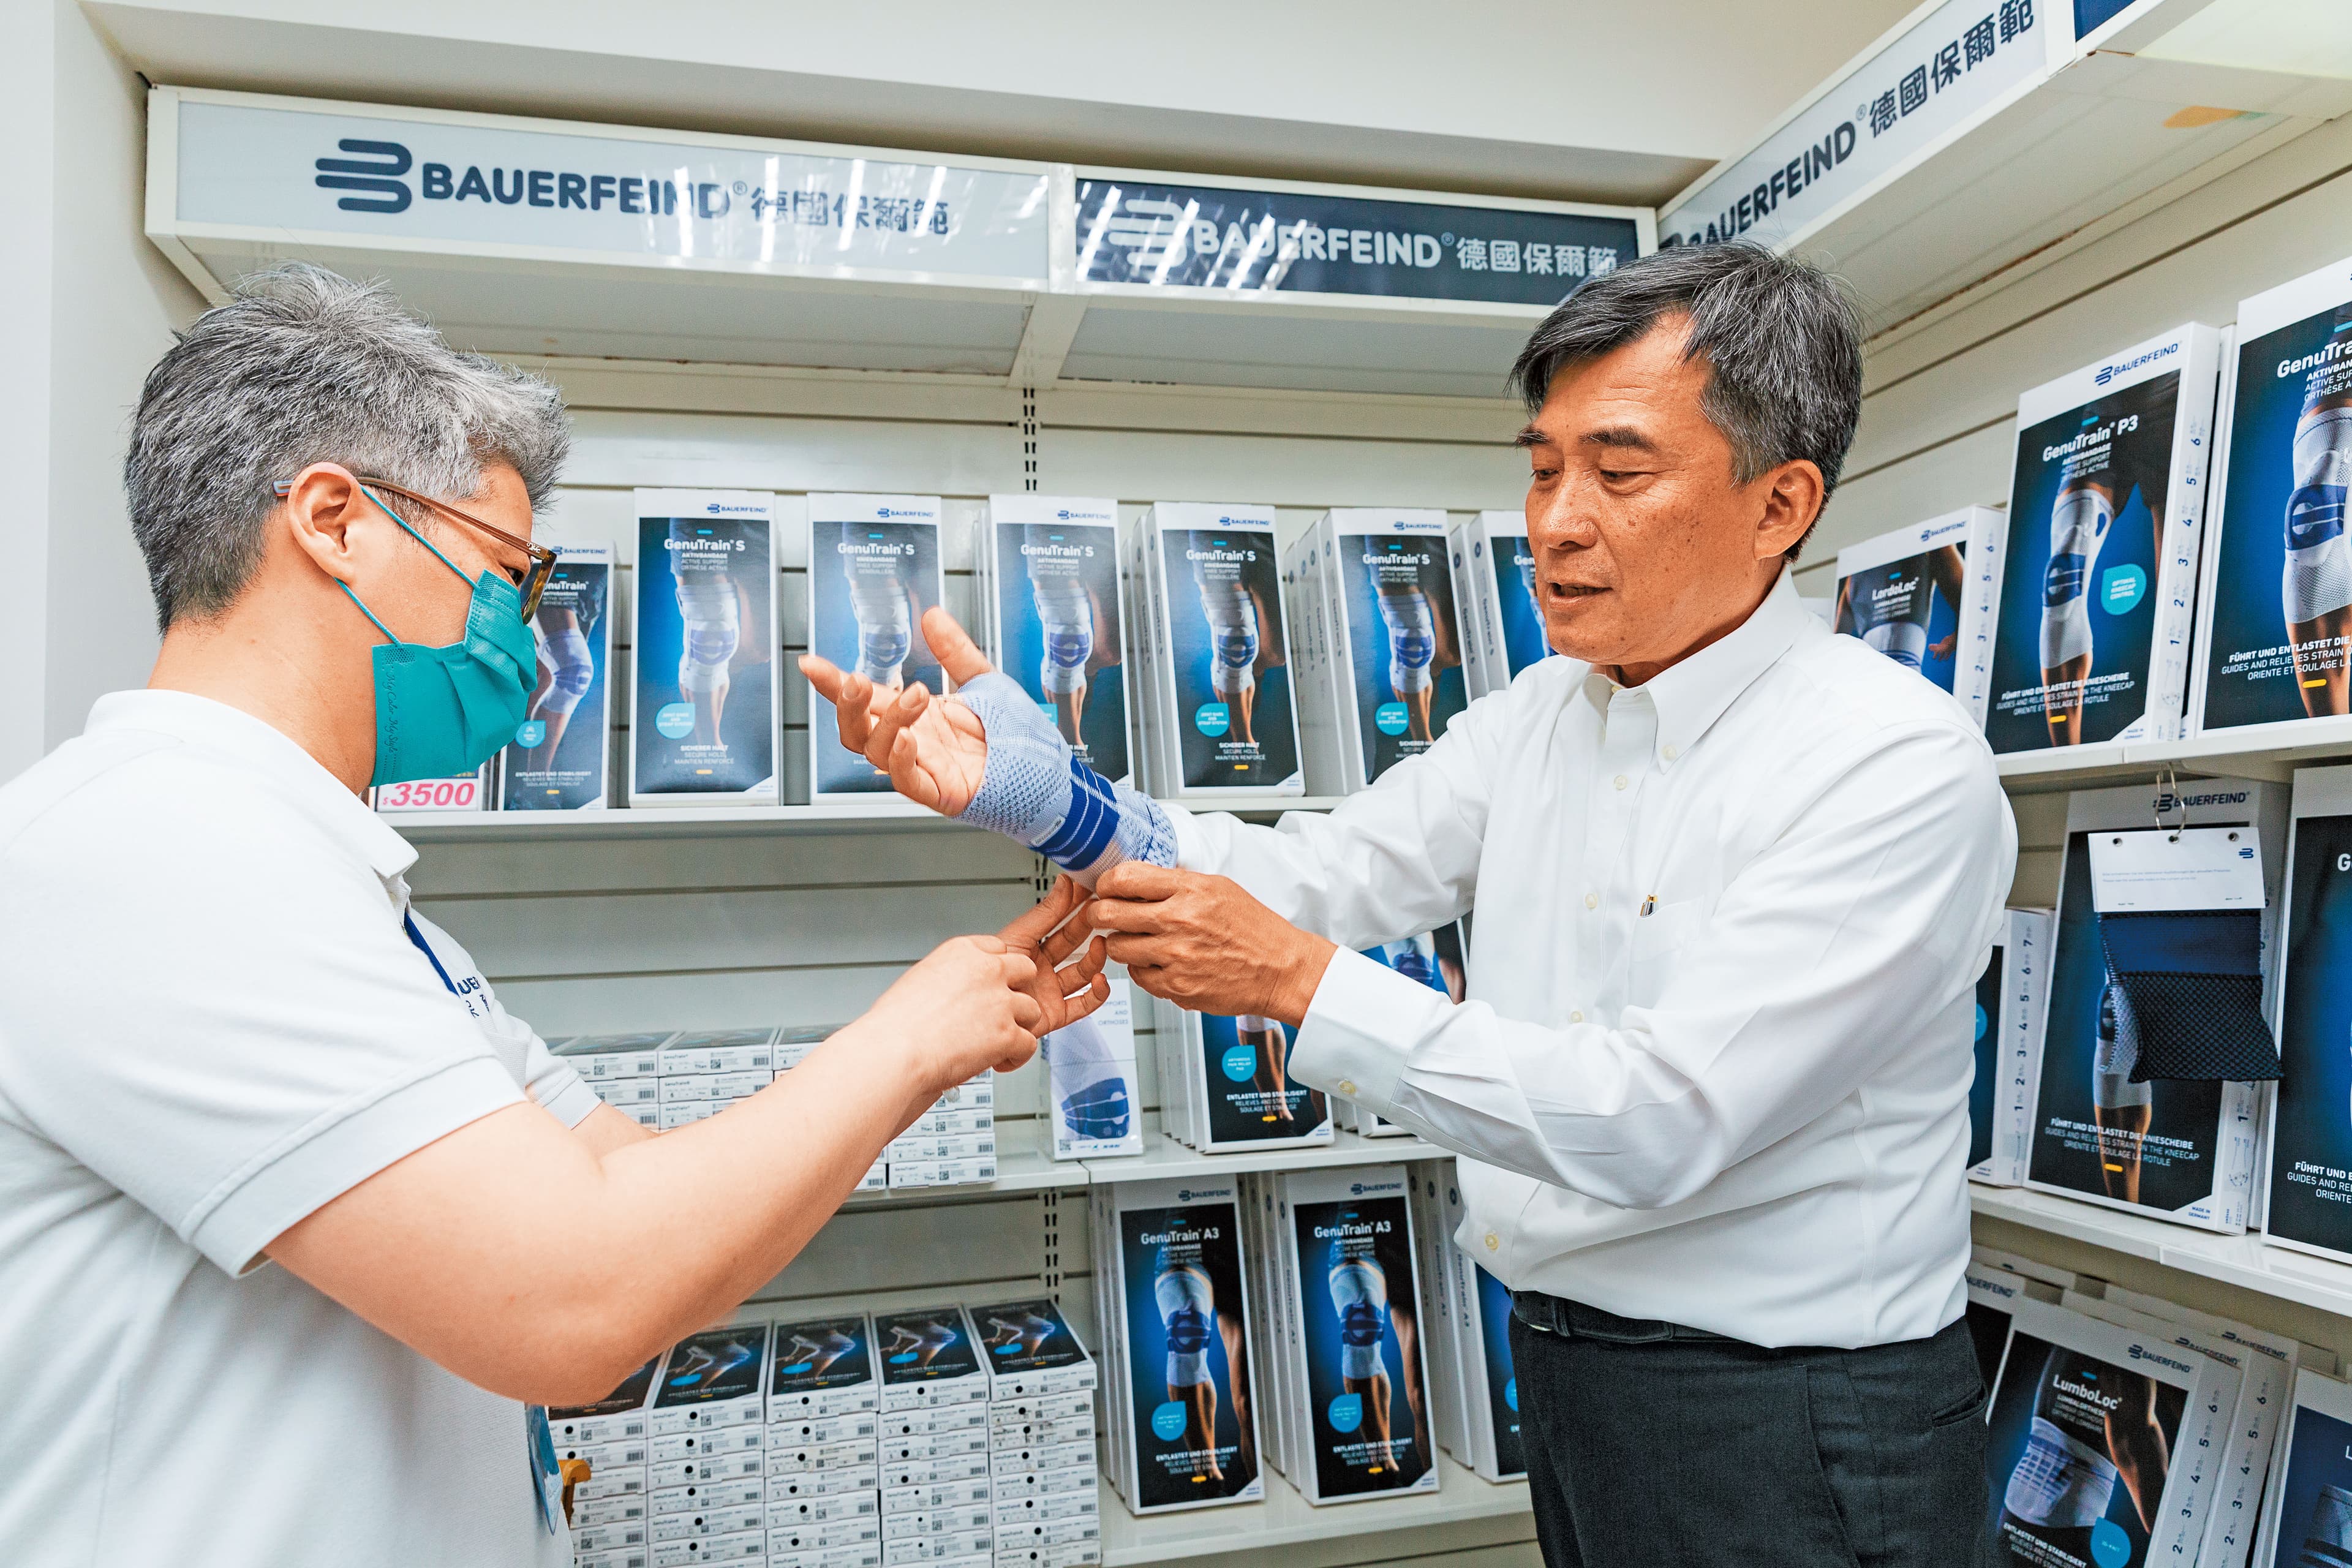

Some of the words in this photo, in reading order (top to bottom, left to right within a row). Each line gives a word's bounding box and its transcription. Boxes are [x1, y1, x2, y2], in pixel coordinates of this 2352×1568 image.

[751, 187, 949, 235] 德國保爾範
[2114, 343, 2178, 376] BAUERFEIND
[2305, 375, 2335, 392] ACTIVE
[2042, 426, 2111, 462] GenuTrain
[2117, 415, 2138, 435] P3
[736, 540, 745, 551] S
[905, 544, 914, 555] S
[1085, 546, 1094, 557] S
[1247, 550, 1256, 562] S
[1422, 554, 1430, 565] S
[2229, 651, 2257, 663] FÜHRT
[2258, 647, 2277, 658] UND
[2278, 638, 2332, 655] ENTLASTET
[2334, 635, 2350, 646] DIE
[2222, 662, 2249, 674] GUIDES
[2250, 660, 2267, 669] AND
[2269, 652, 2309, 666] RELIEVES
[2311, 647, 2344, 661] STRAIN
[2247, 668, 2282, 680] ORIENTE
[2283, 666, 2295, 675] ET
[2297, 660, 2337, 673] SOULAGE
[2143, 1134, 2194, 1150] KNIESCHEIBE
[2295, 1161, 2325, 1175] FÜHRT
[2326, 1167, 2346, 1179] UND
[2287, 1172, 2317, 1185] GUIDES
[2318, 1178, 2337, 1189] AND
[1140, 1229, 1200, 1245] GenuTrain
[1204, 1227, 1219, 1239] A3
[1314, 1223, 1372, 1238] GenuTrain
[1376, 1221, 1392, 1234] A3
[2143, 1351, 2191, 1373] BAUERFEIND
[2052, 1374, 2119, 1410] LumboLoc
